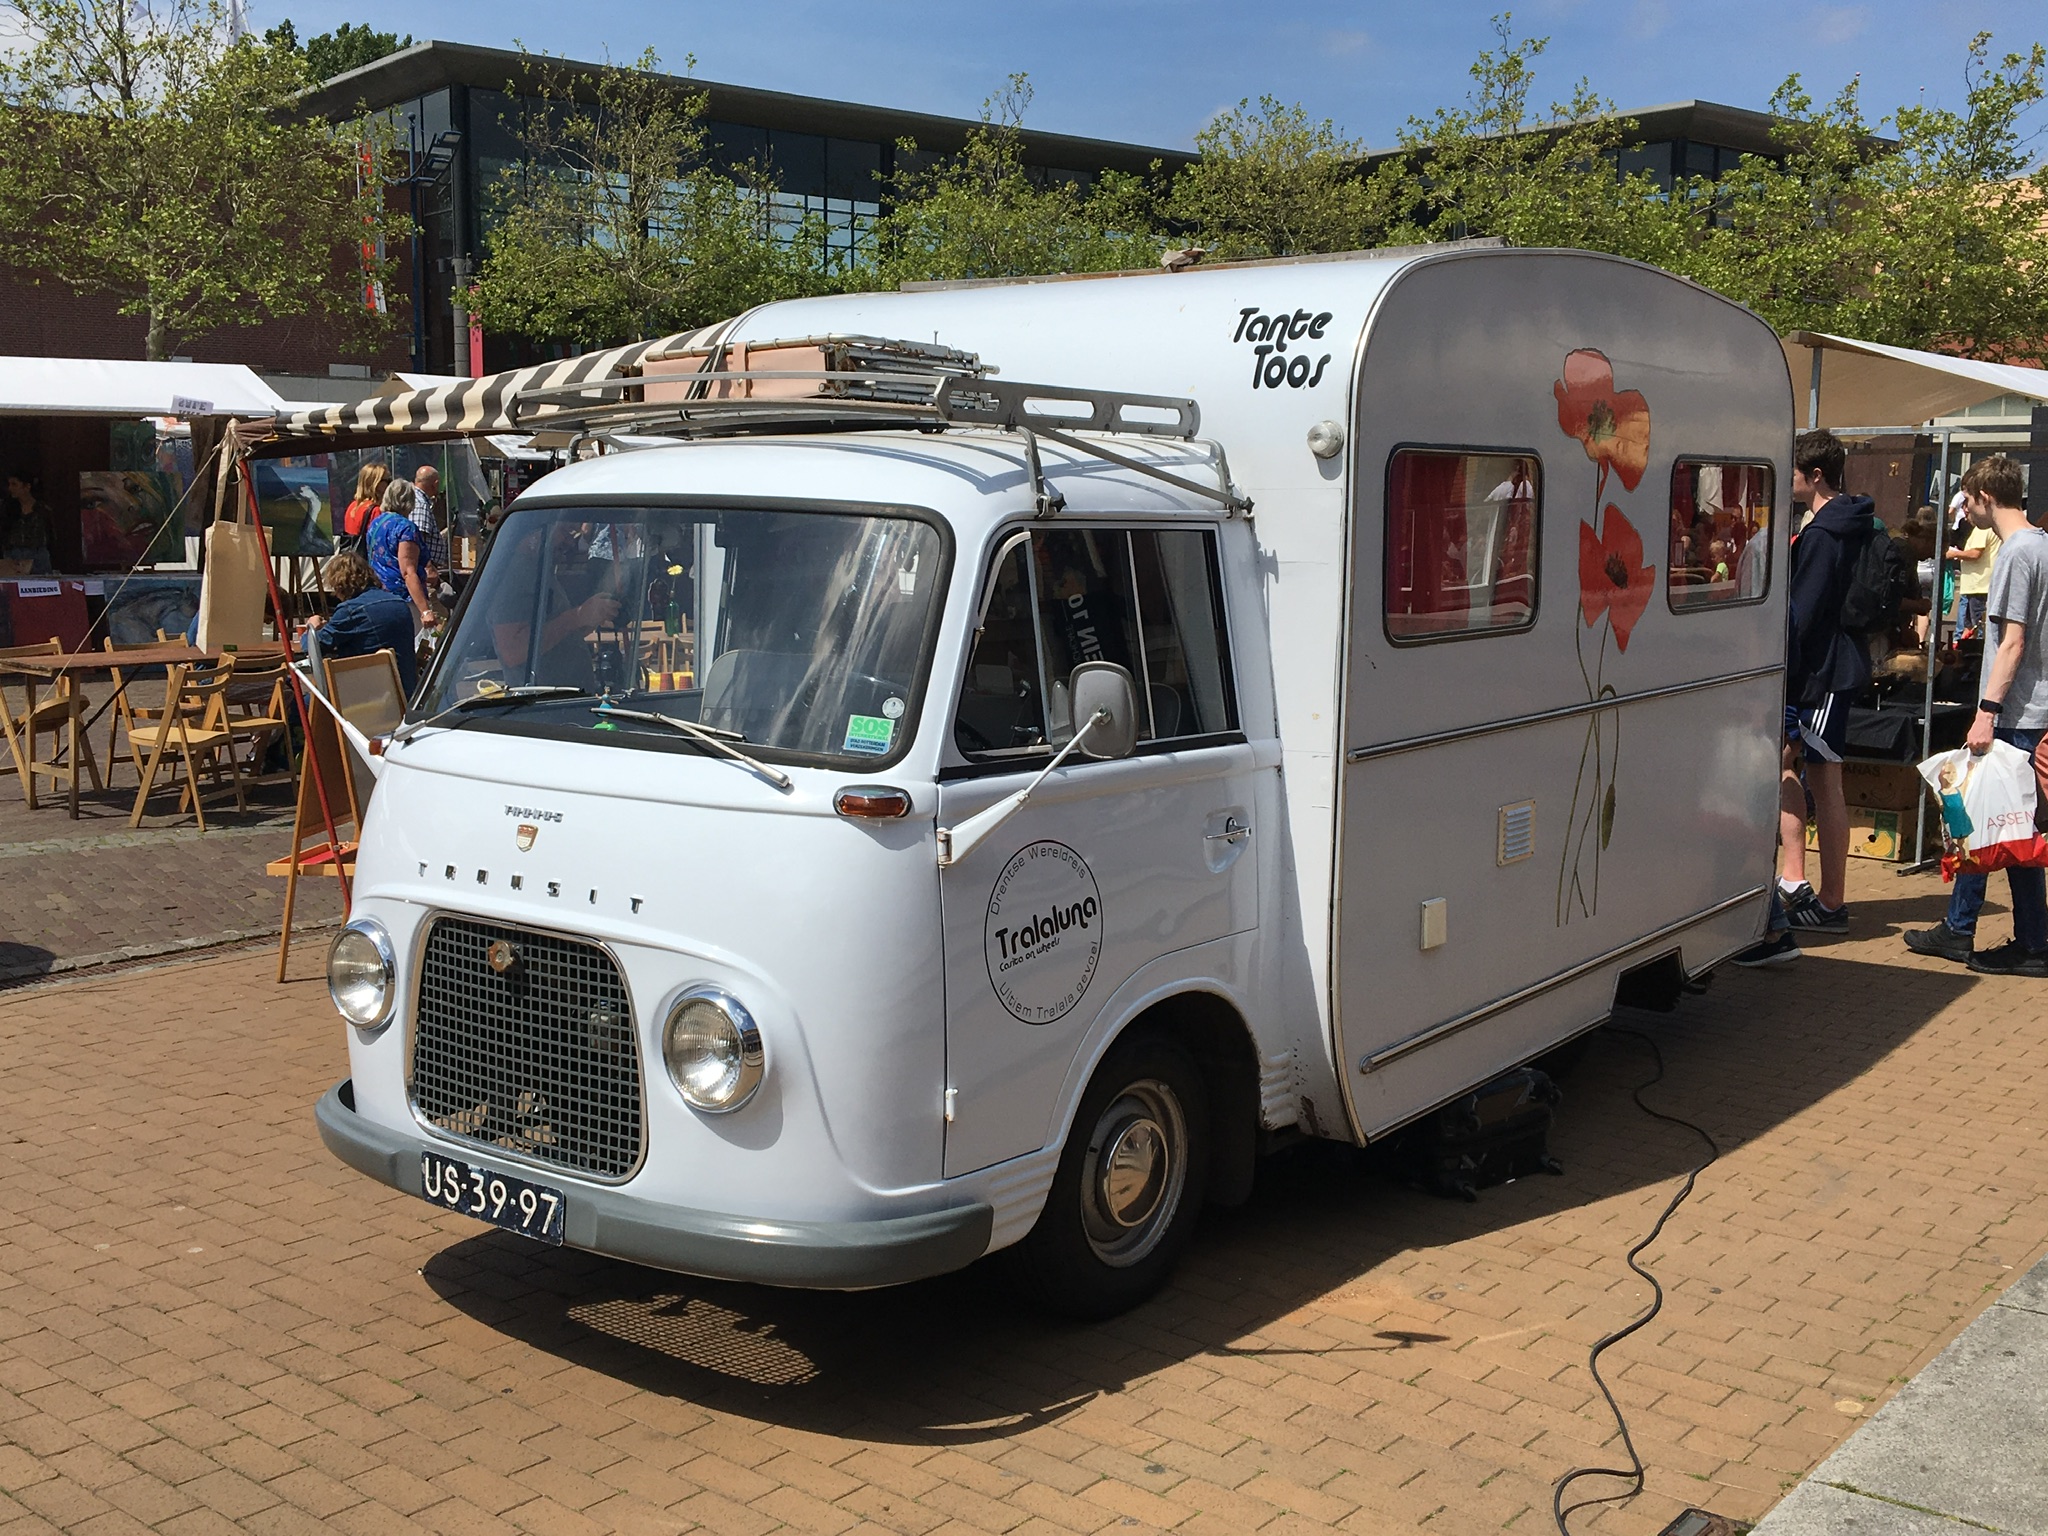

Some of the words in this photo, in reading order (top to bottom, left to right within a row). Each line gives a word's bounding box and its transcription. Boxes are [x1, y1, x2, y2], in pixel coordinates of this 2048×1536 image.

[1233, 307, 1333, 353] Tante
[1252, 344, 1332, 389] Toos
[851, 716, 892, 736] SOS
[1986, 810, 2035, 829] ASSEN
[418, 859, 644, 914] TRANSIT
[990, 857, 1026, 915] Drentse
[1028, 846, 1086, 879] Wereldreis
[995, 896, 1097, 959] Tralaluna
[1025, 951, 1037, 960] on
[1036, 937, 1060, 954] wheels
[999, 981, 1032, 1017] Ultiem
[1036, 993, 1075, 1019] Tralala
[1075, 940, 1098, 994] gevoel
